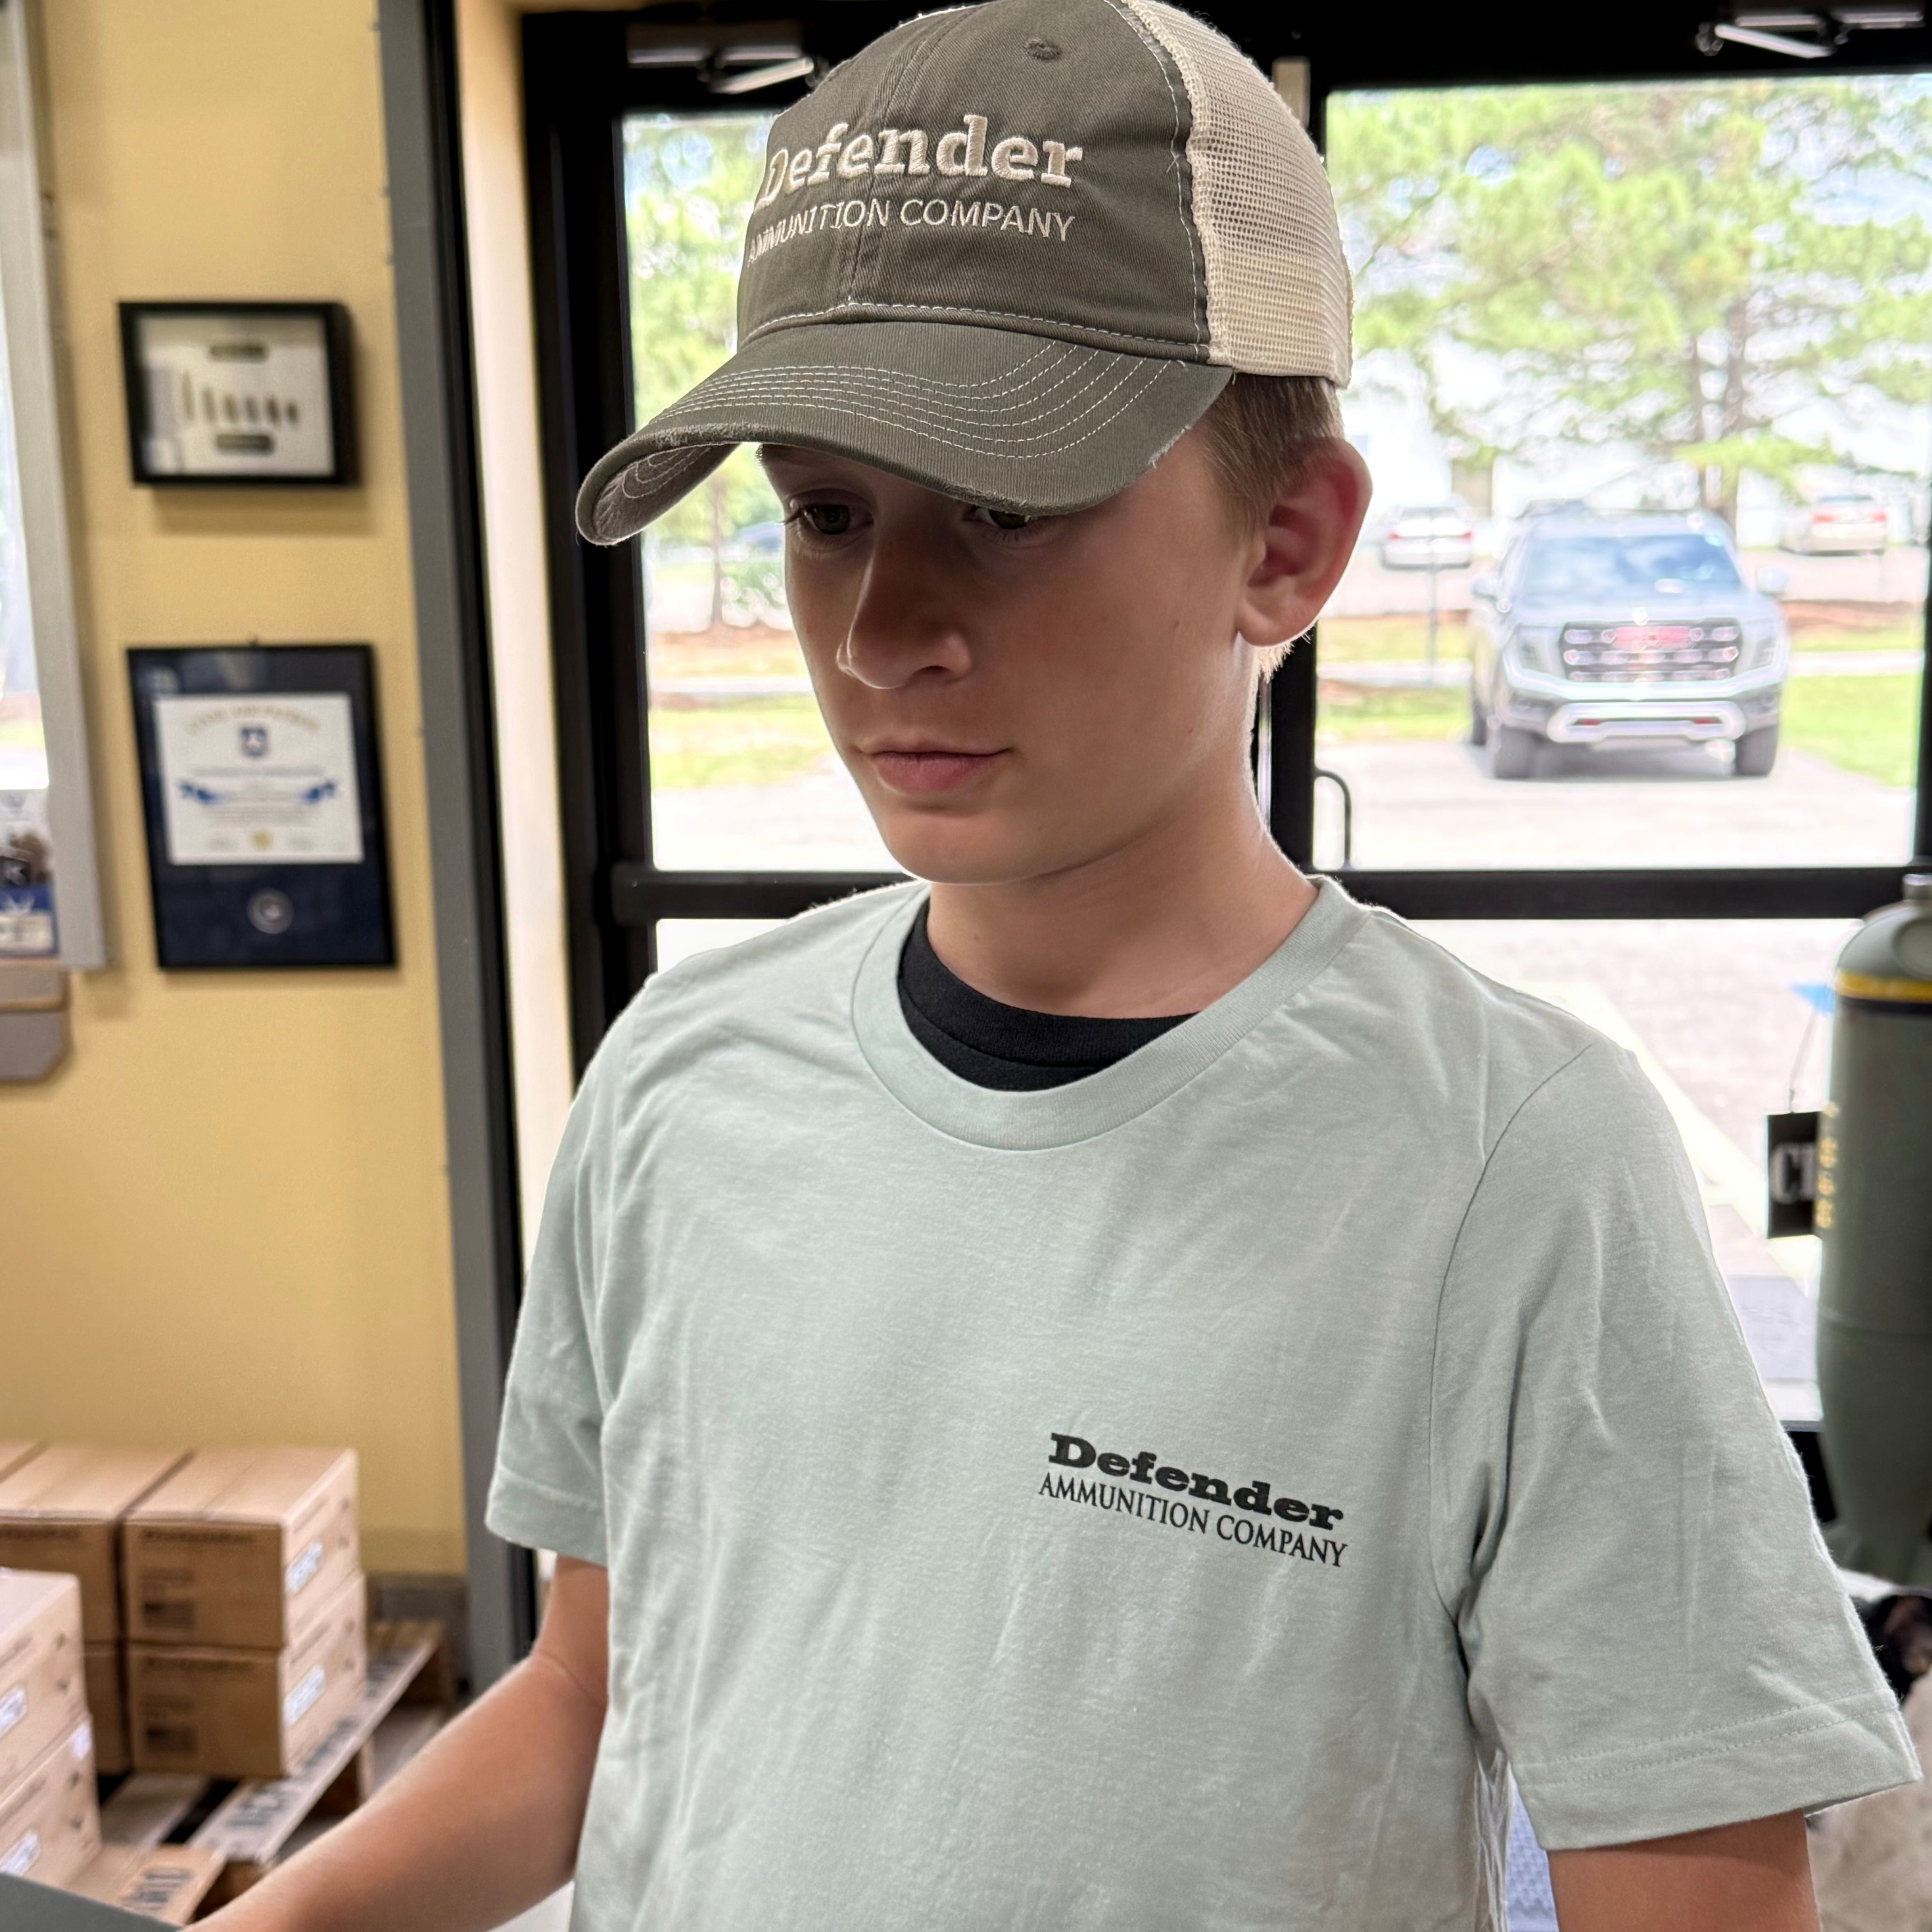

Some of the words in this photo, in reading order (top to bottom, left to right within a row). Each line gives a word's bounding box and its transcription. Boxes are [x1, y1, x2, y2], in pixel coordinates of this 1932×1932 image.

[753, 114, 1083, 216] Defender
[747, 199, 890, 268] AMMUNITION
[900, 199, 1075, 241] COMPANY
[1038, 1472, 1210, 1534] AMMUNITION
[1216, 1514, 1348, 1568] COMPANY
[1048, 1432, 1344, 1530] Defender
